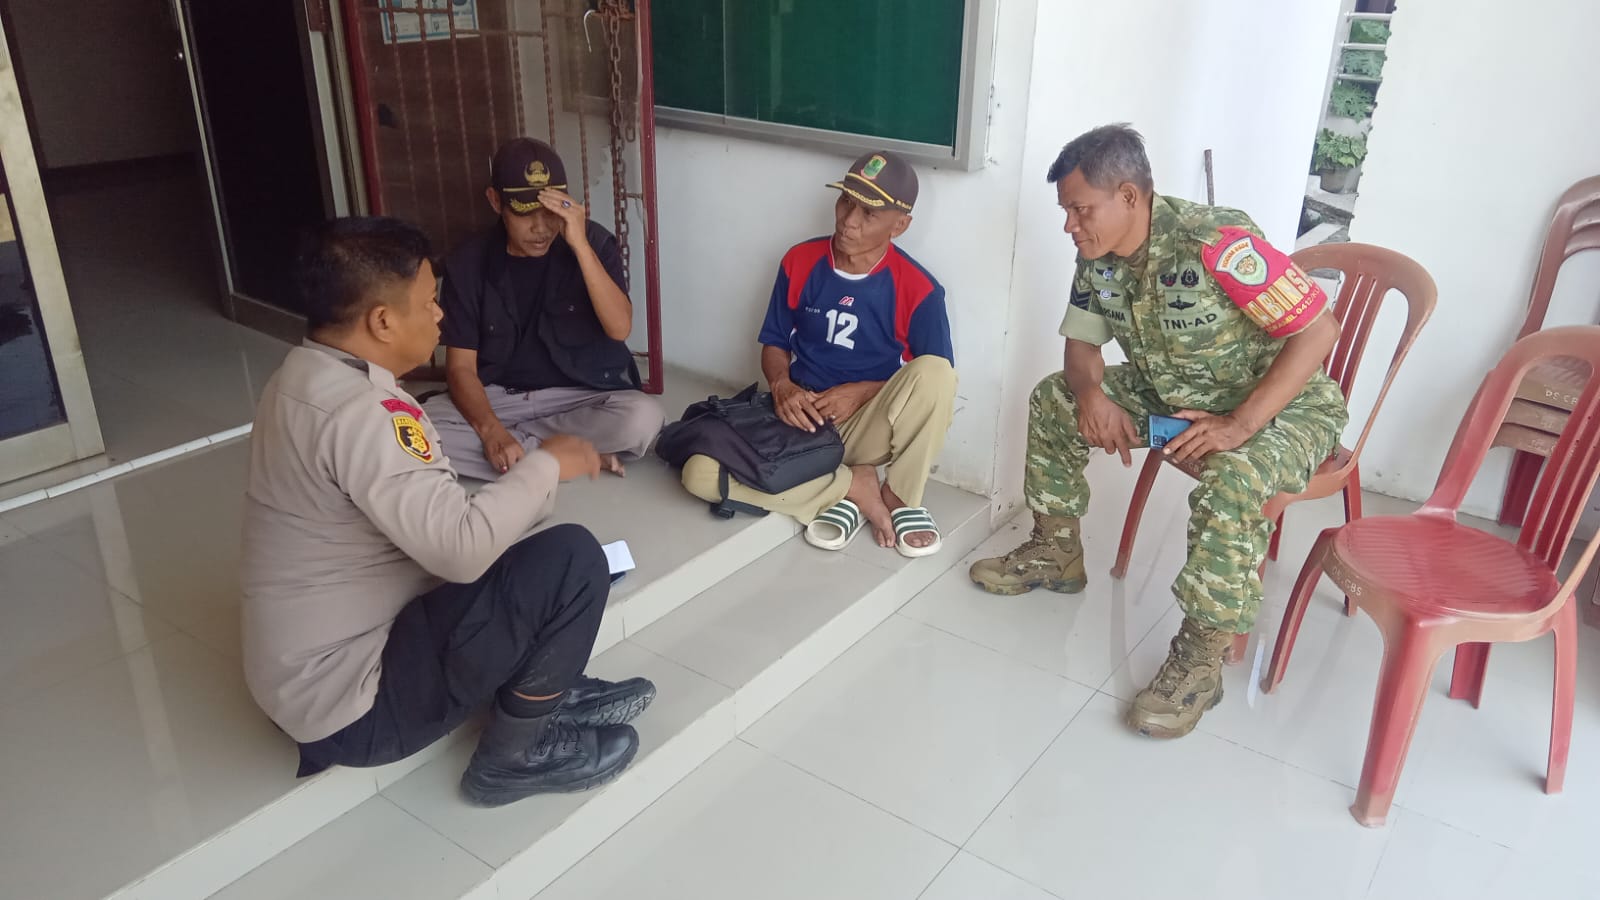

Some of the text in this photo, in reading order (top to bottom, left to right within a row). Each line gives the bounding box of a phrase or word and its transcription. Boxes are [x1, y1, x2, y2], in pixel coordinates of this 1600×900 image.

[1241, 262, 1314, 327] ABINSA
[825, 308, 859, 350] 12
[1163, 313, 1218, 330] TNI-AD
